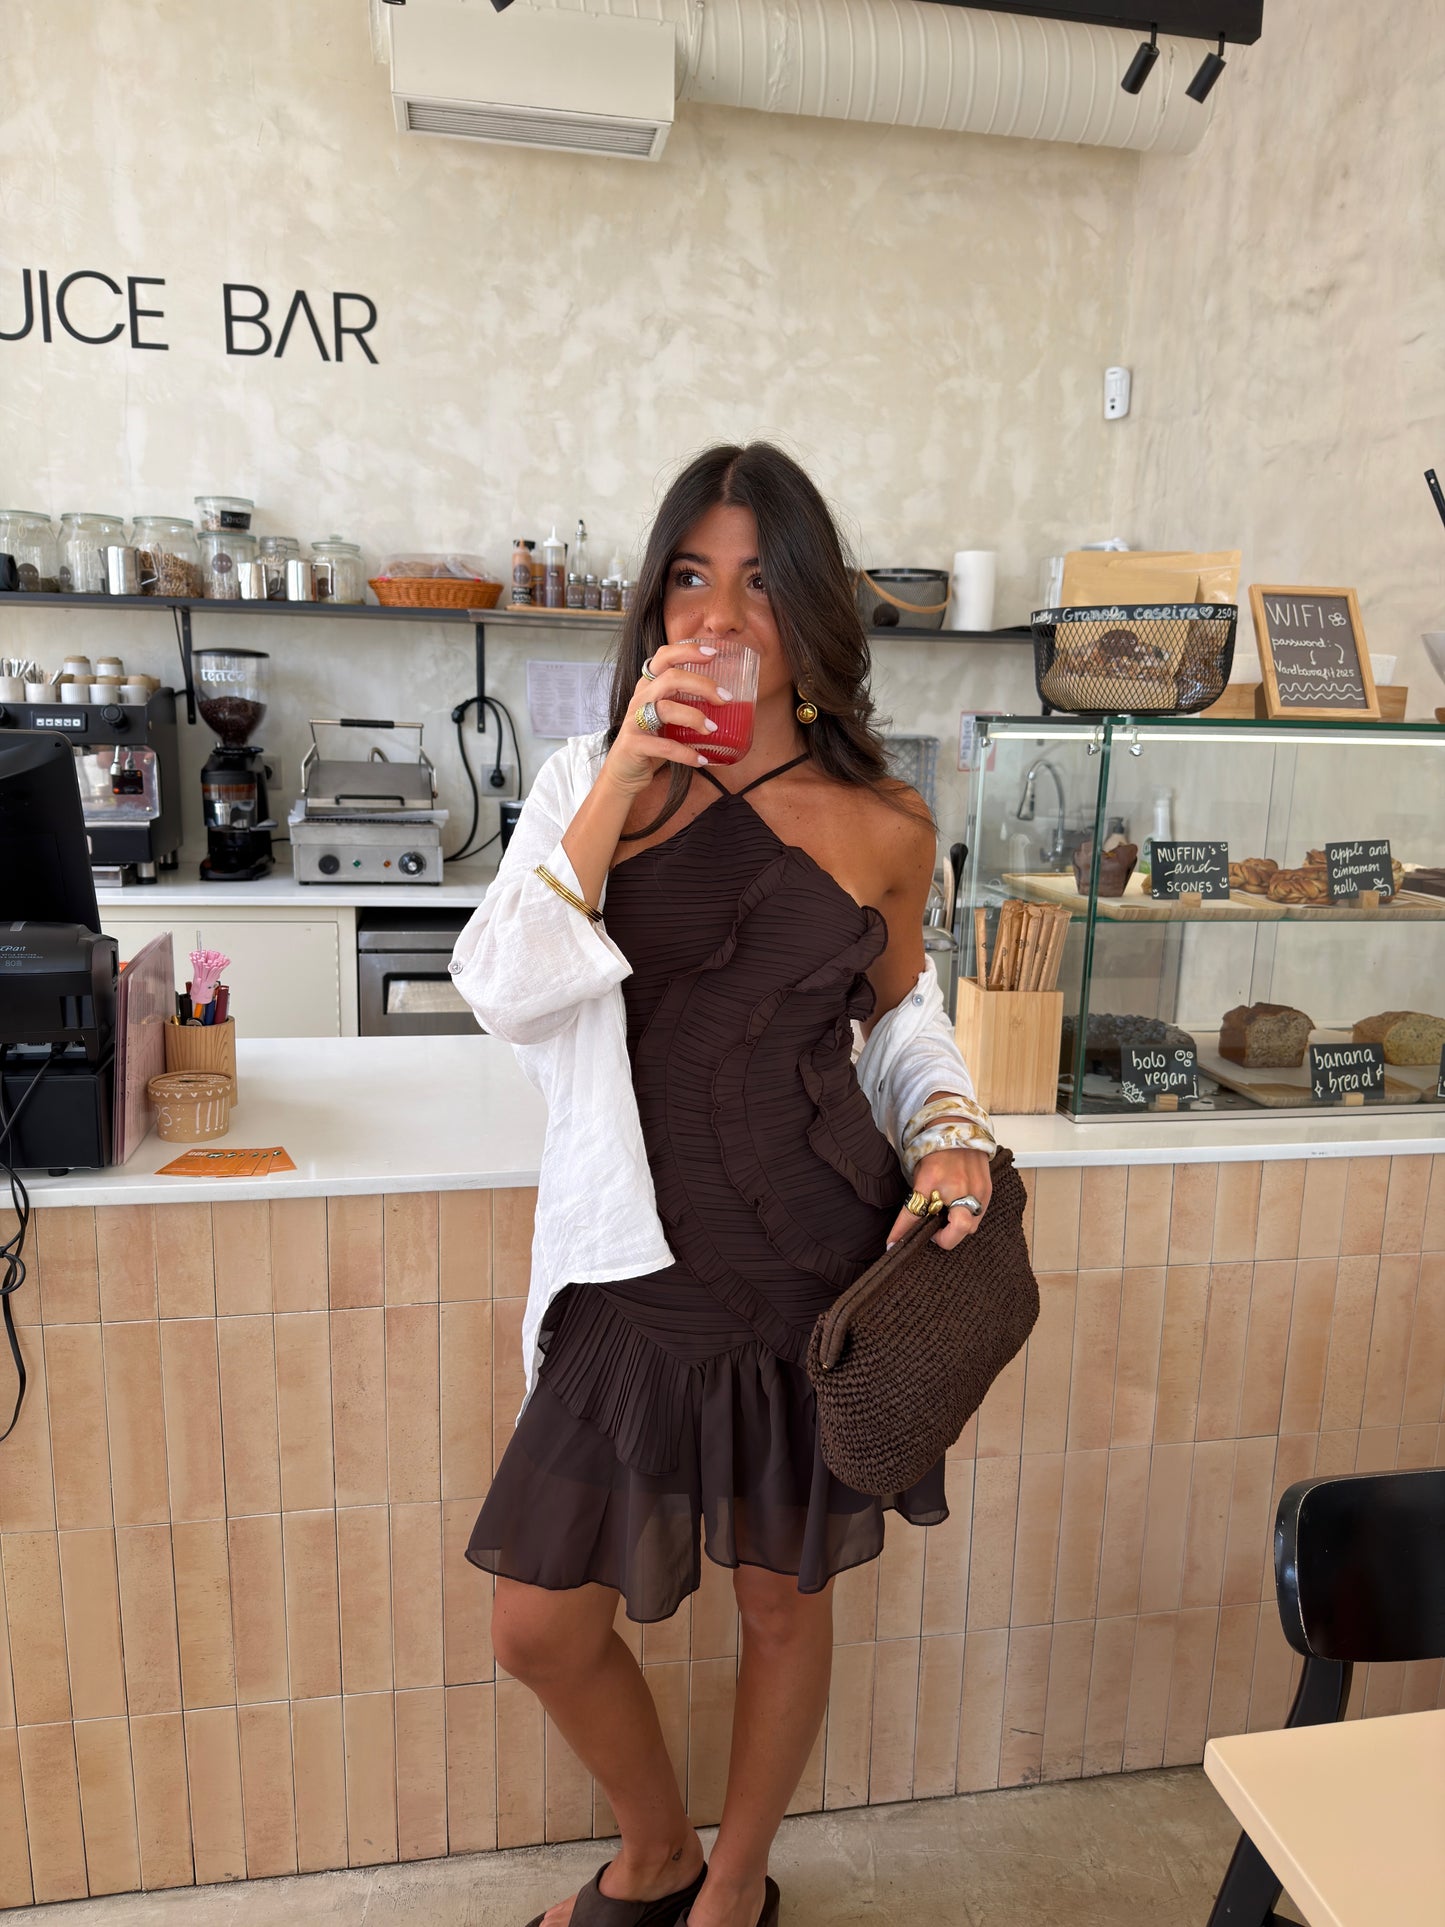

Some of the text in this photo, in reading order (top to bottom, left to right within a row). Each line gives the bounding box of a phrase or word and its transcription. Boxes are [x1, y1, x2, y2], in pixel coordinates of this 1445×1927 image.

[223, 283, 379, 364] BAR
[1062, 606, 1129, 621] Granola
[1133, 605, 1200, 620] caseira
[1265, 602, 1324, 629] WIFI
[1330, 841, 1389, 866] apple and
[1164, 859, 1220, 876] and
[1332, 863, 1380, 879] cinnamon
[1166, 881, 1213, 893] SCONES
[1333, 878, 1358, 895] rolls
[1132, 1050, 1166, 1070] bolo
[1313, 1048, 1376, 1070] banana
[1145, 1071, 1187, 1091] vegan
[1328, 1066, 1374, 1093] bread
